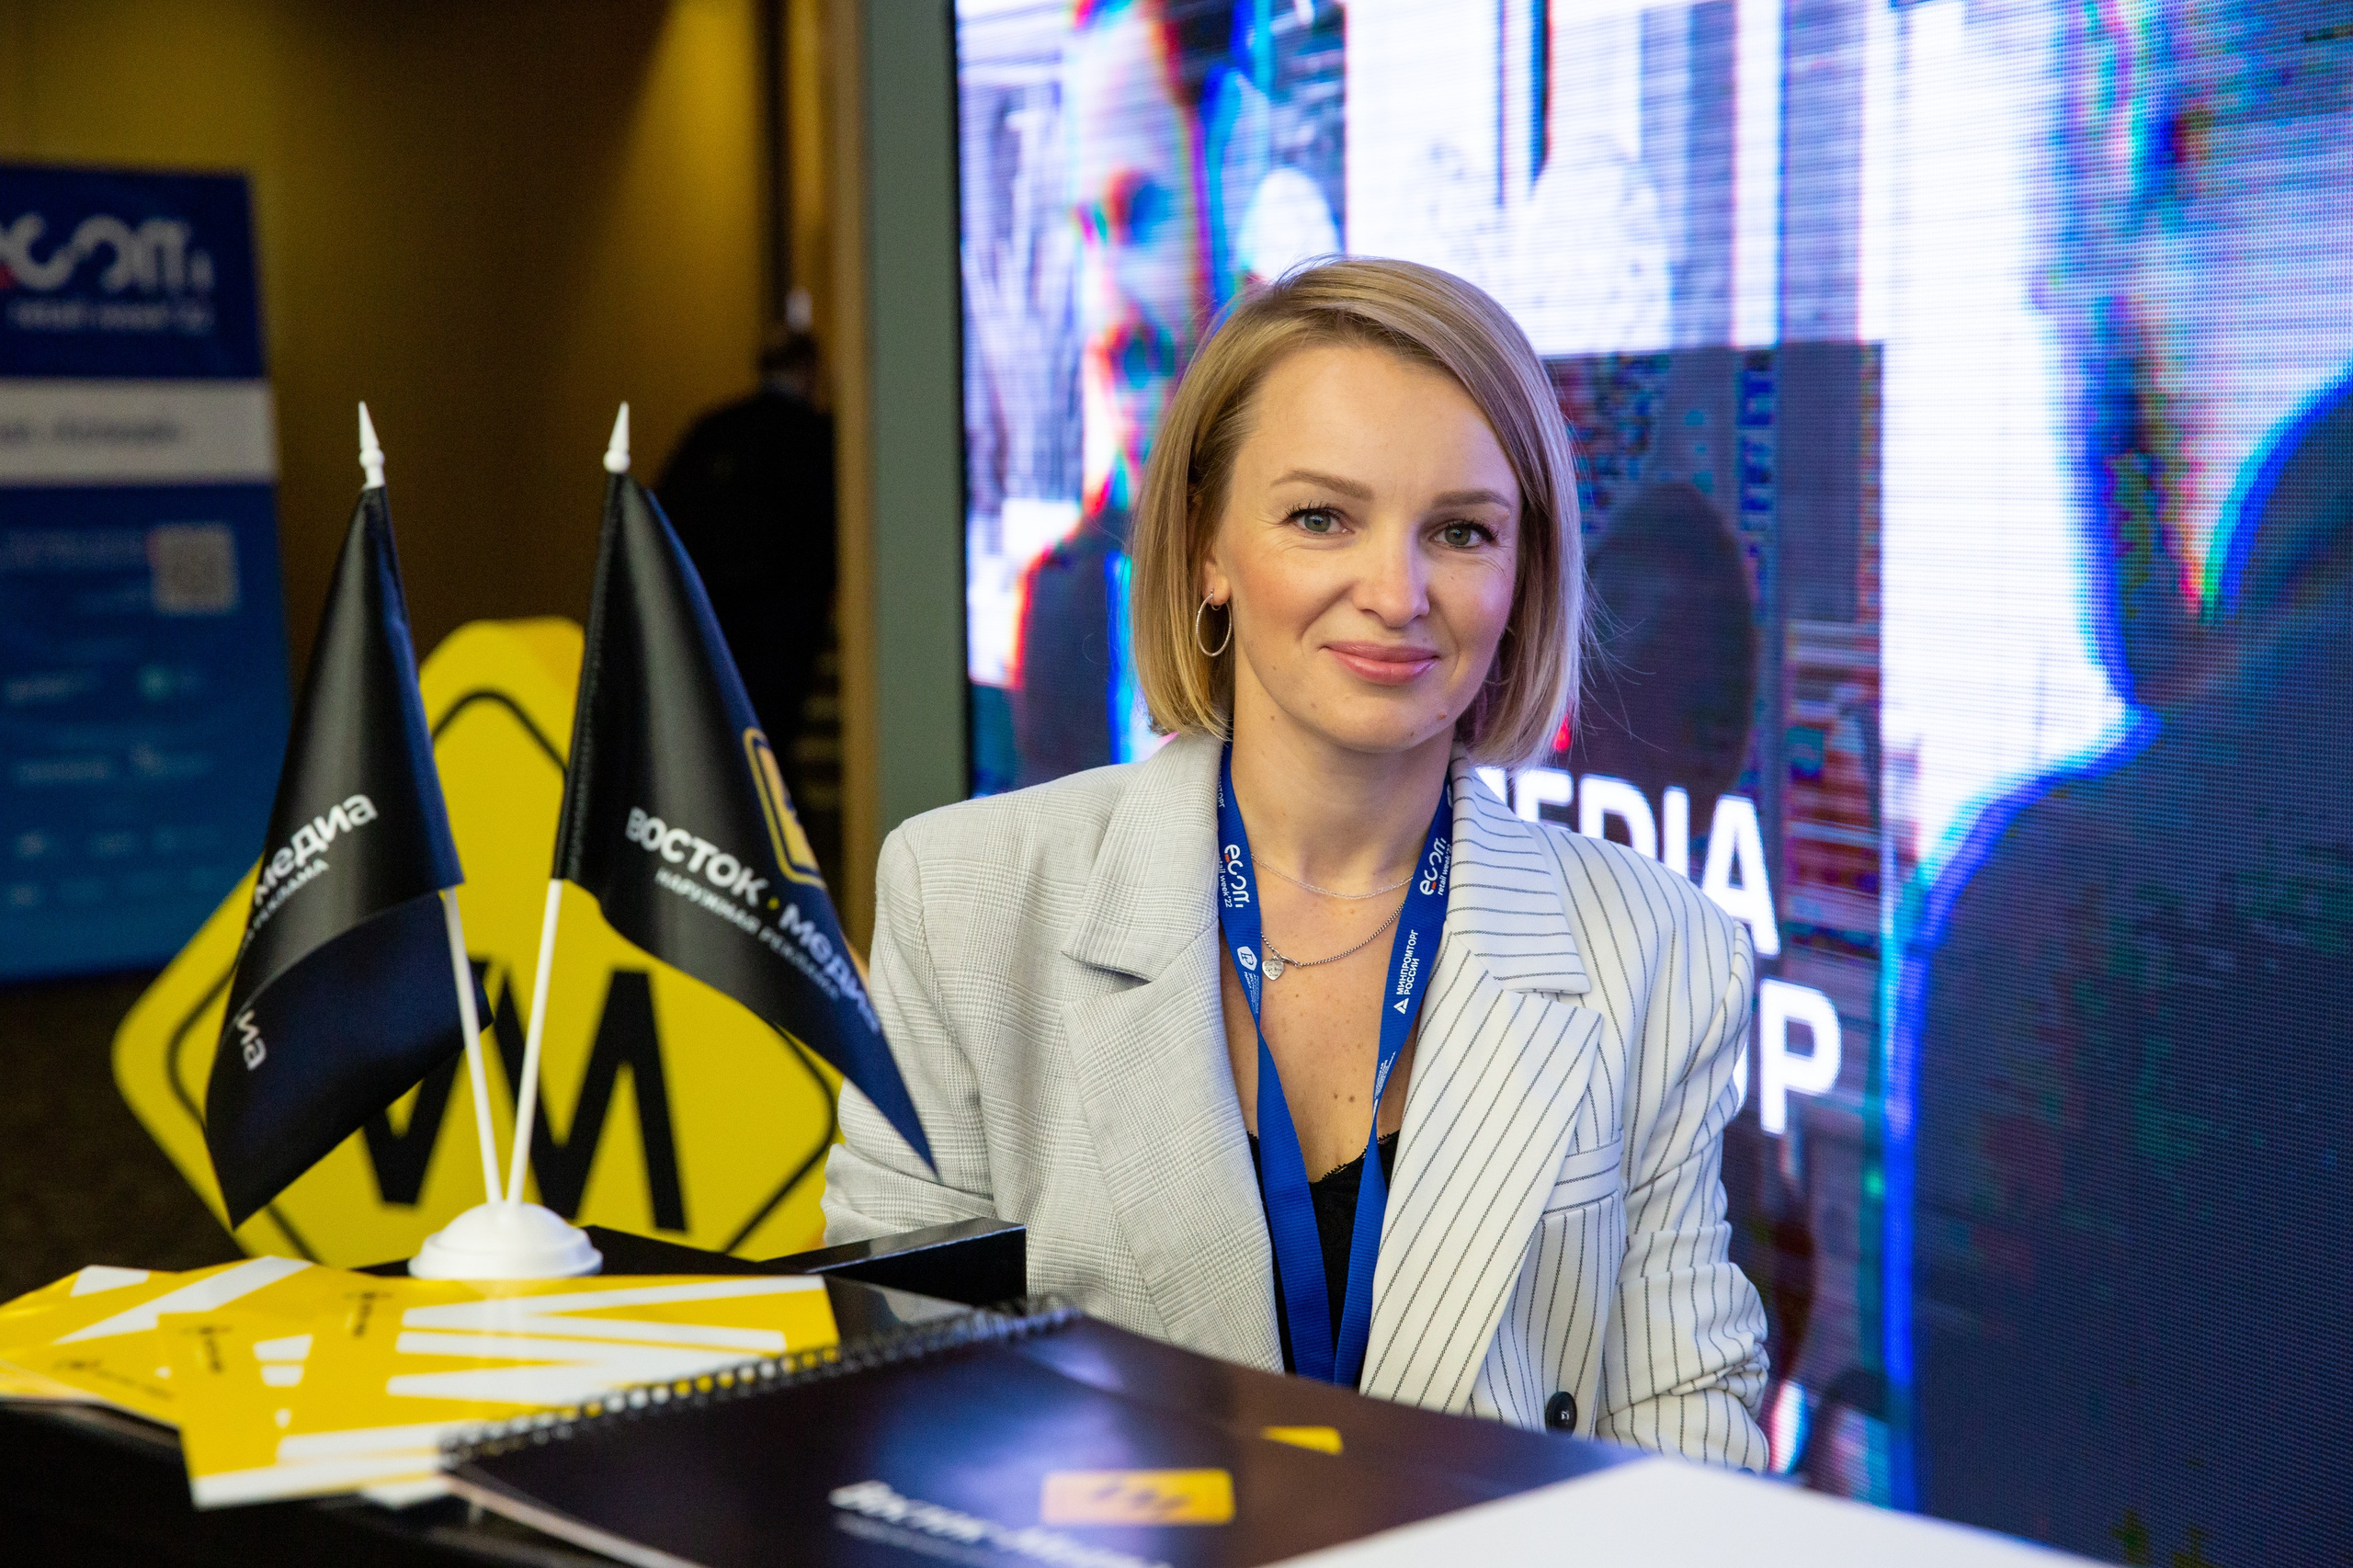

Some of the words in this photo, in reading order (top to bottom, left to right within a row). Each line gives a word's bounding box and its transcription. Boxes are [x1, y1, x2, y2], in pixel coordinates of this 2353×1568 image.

[625, 806, 769, 907] ВОСТОК
[1220, 875, 1233, 908] week'22
[1395, 928, 1419, 995] МИНПРОМТОРГ
[1404, 958, 1420, 995] РОССИИ
